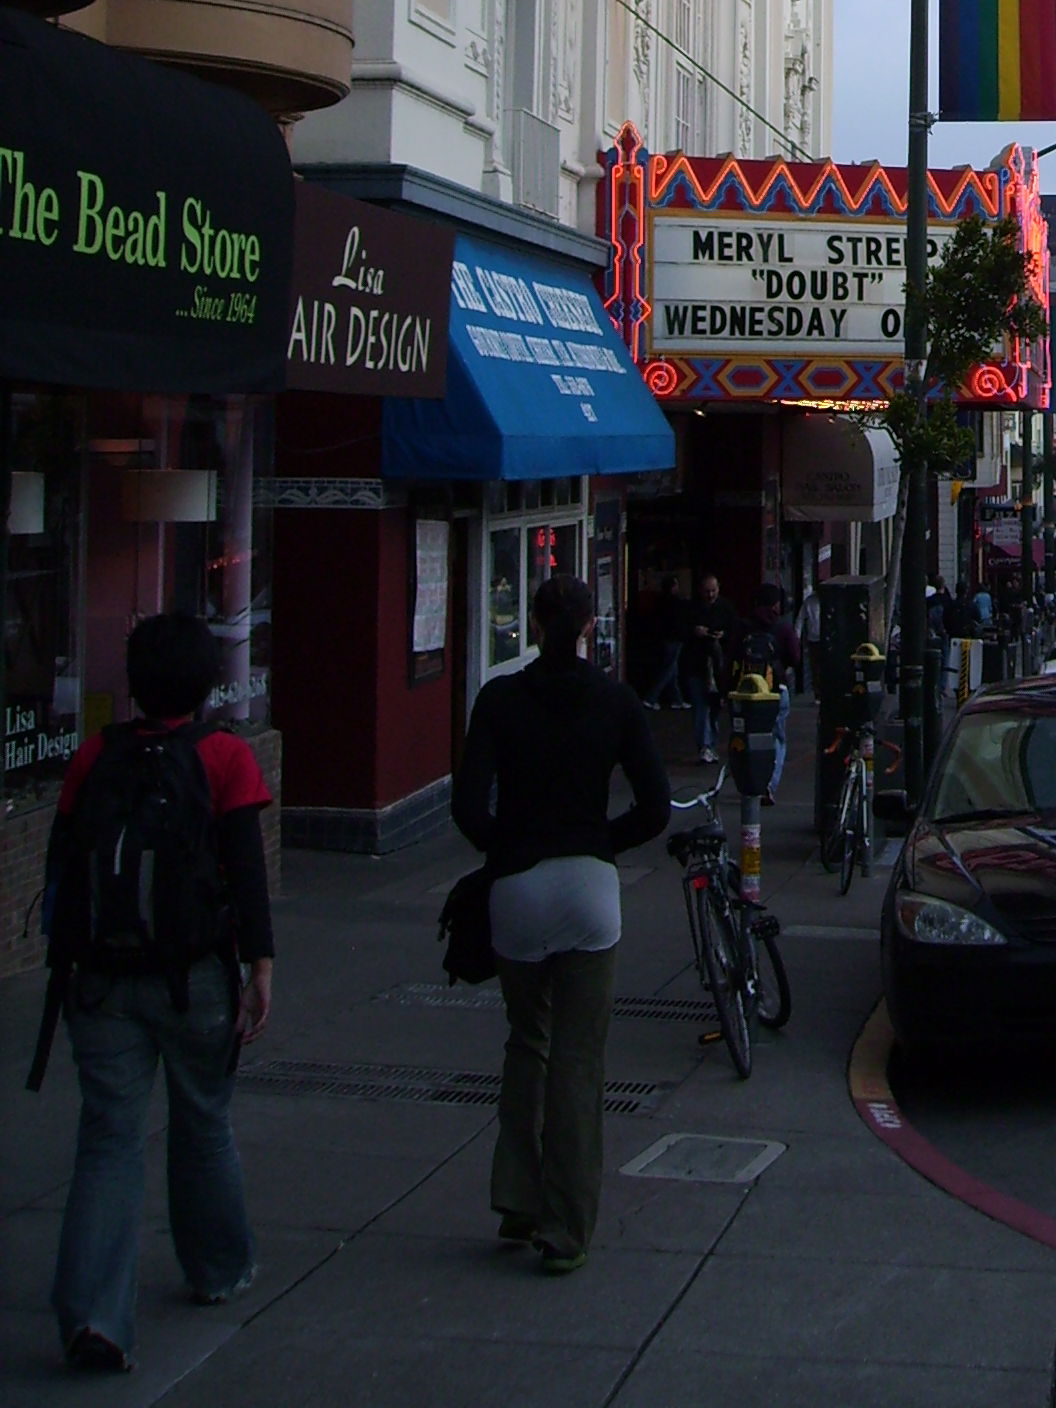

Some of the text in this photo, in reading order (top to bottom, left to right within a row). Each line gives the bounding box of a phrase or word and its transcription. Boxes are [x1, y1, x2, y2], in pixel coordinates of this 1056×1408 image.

[73, 169, 167, 268] Bead
[181, 196, 262, 283] Store
[692, 230, 938, 266] MERYL STREP
[332, 226, 385, 296] Lisa
[226, 291, 258, 325] 1964
[451, 260, 488, 313] HE
[475, 265, 544, 325] CASTRO
[286, 294, 336, 366] AIR
[345, 305, 431, 374] DESIGN
[664, 304, 847, 338] WEDNESDAY
[5, 704, 37, 737] Lisa
[4, 728, 79, 773] Hair Design
